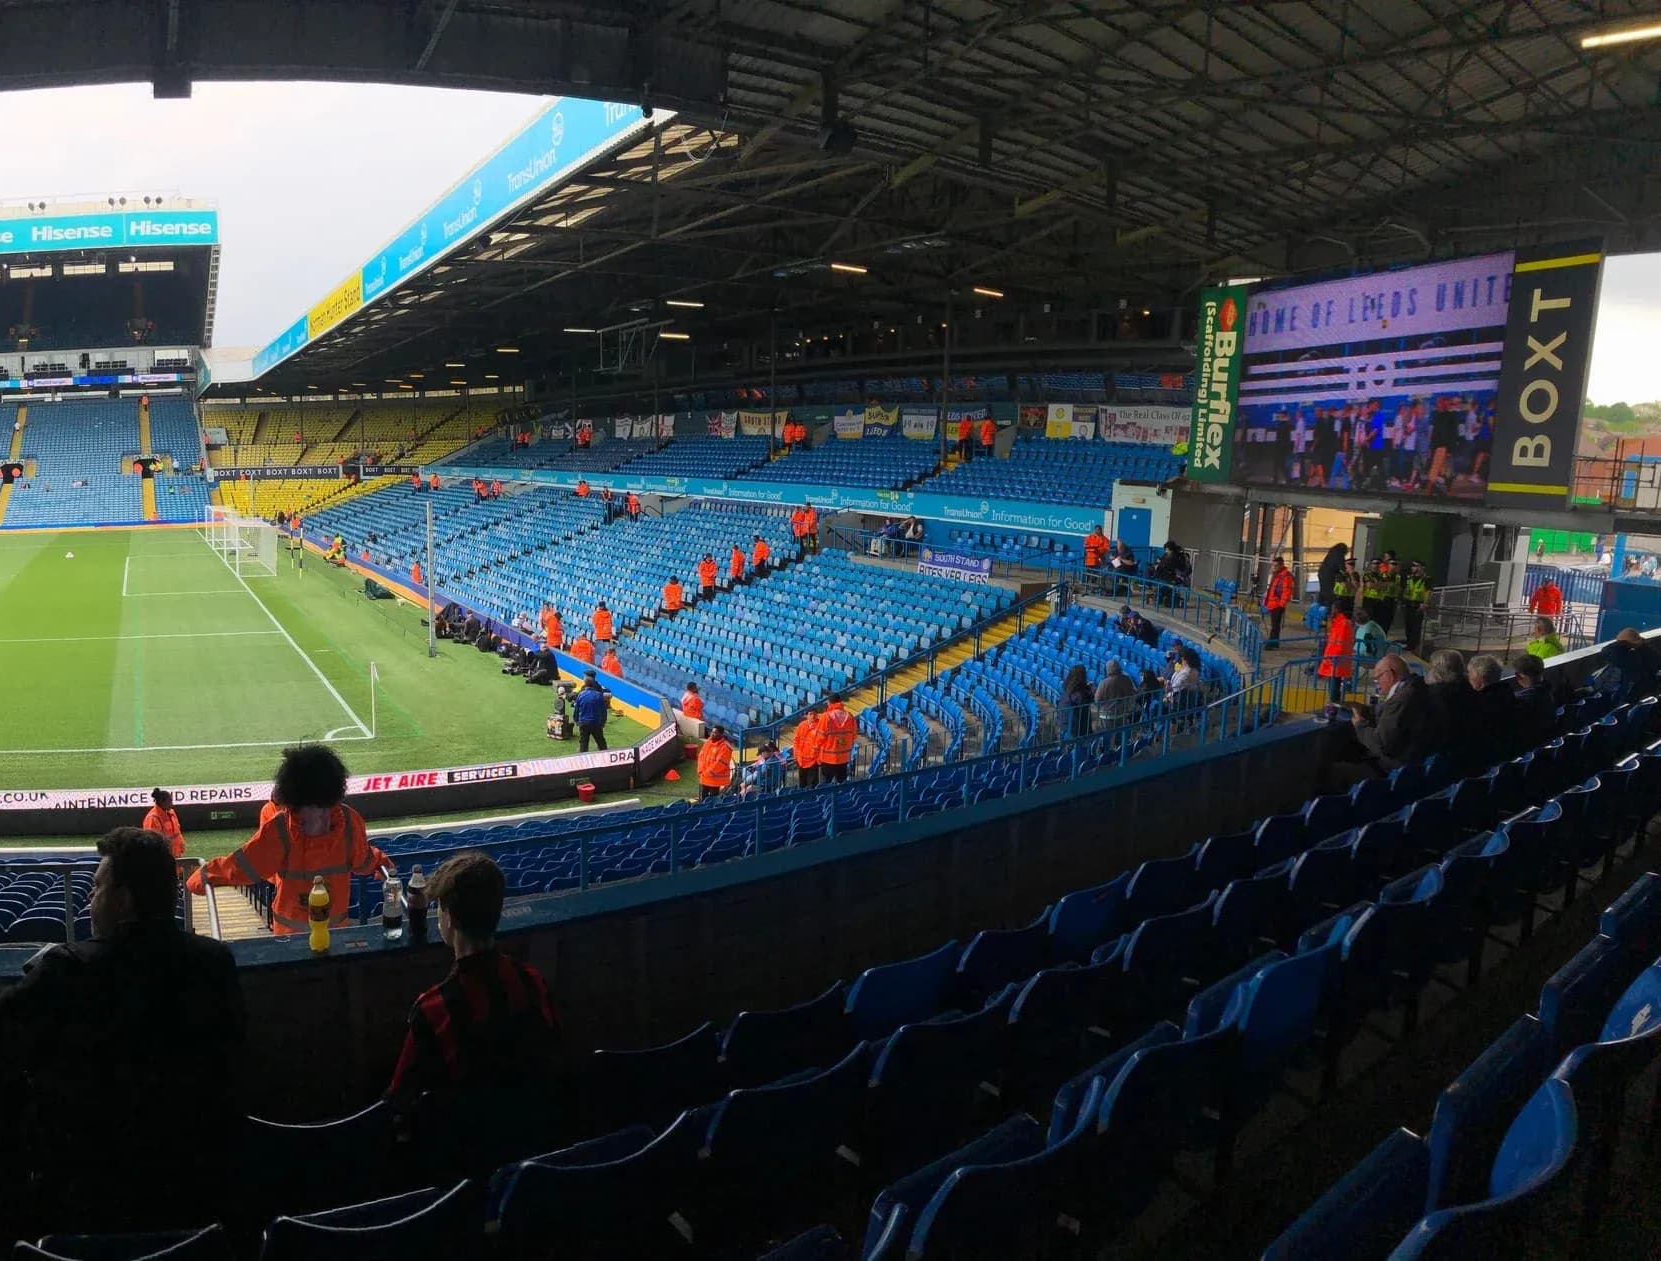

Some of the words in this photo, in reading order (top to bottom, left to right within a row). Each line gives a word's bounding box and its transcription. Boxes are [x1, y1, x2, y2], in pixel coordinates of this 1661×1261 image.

[507, 149, 555, 193] TransUnion
[130, 220, 212, 236] Hisense
[443, 208, 477, 239] TransUnion
[31, 225, 112, 241] Hisense
[1248, 305, 1297, 336] HOME
[1311, 300, 1334, 328] OF
[1348, 287, 1418, 324] LEEDS
[1197, 301, 1217, 404] (Scaffolding)
[1511, 288, 1571, 467] BOXT
[1204, 331, 1237, 470] Burflex
[1134, 409, 1149, 419] Real
[1193, 408, 1208, 468] Limited
[215, 468, 236, 477] BOXT
[267, 468, 289, 477] BOXT
[292, 467, 313, 476] BOXT
[317, 467, 337, 475] BOXT
[840, 496, 879, 509] Information
[881, 499, 890, 509] for
[892, 500, 911, 511] Good
[943, 505, 983, 519] TransUnion
[992, 510, 1045, 526] Information
[1048, 517, 1062, 528] for
[1064, 517, 1091, 531] Good
[935, 553, 955, 563] SOUTH
[955, 556, 980, 568] STAND
[610, 751, 635, 763] DRA
[453, 765, 513, 781] SERVICES
[363, 774, 393, 791] JET
[398, 772, 438, 788] AIRE
[43, 792, 147, 810] AINTENANCE
[190, 787, 252, 802] REPAIRS
